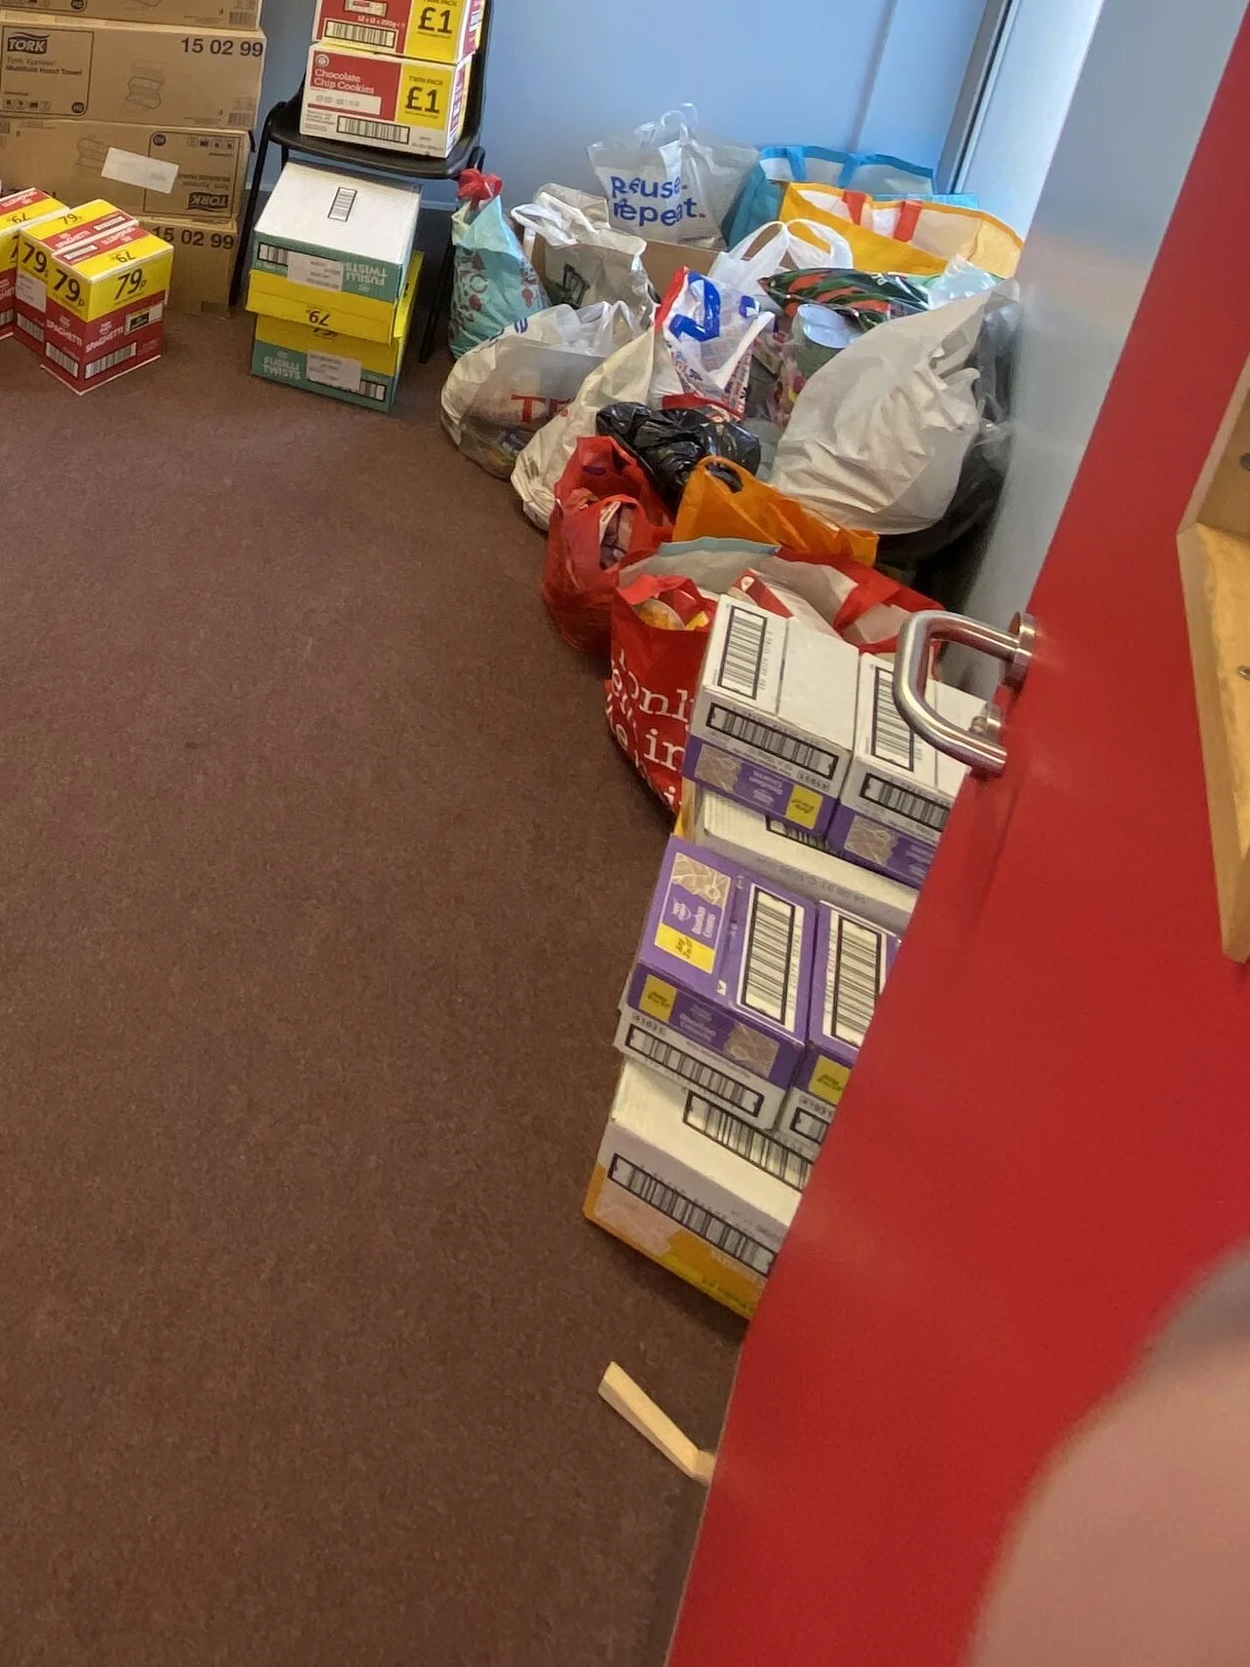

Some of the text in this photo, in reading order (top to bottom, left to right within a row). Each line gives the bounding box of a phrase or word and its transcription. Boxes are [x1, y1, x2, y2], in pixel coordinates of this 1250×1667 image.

[417, 7, 452, 33] £1
[9, 38, 46, 53] TORK
[182, 37, 263, 57] 15 02 99
[6, 64, 82, 77] Multifold Hand Towel
[314, 68, 361, 83] Chocolate
[313, 77, 375, 94] Chip Cookies
[408, 75, 443, 86] TWIN PACK
[405, 85, 440, 114] £1
[190, 194, 227, 208] TORK
[153, 226, 235, 250] 15 02 99
[345, 262, 388, 278] TWISTS
[114, 268, 147, 302] 79p
[345, 272, 386, 286] FUSILLI
[54, 268, 85, 308] 79p
[263, 355, 300, 370] FUSILLI
[263, 364, 301, 380] TWISTS
